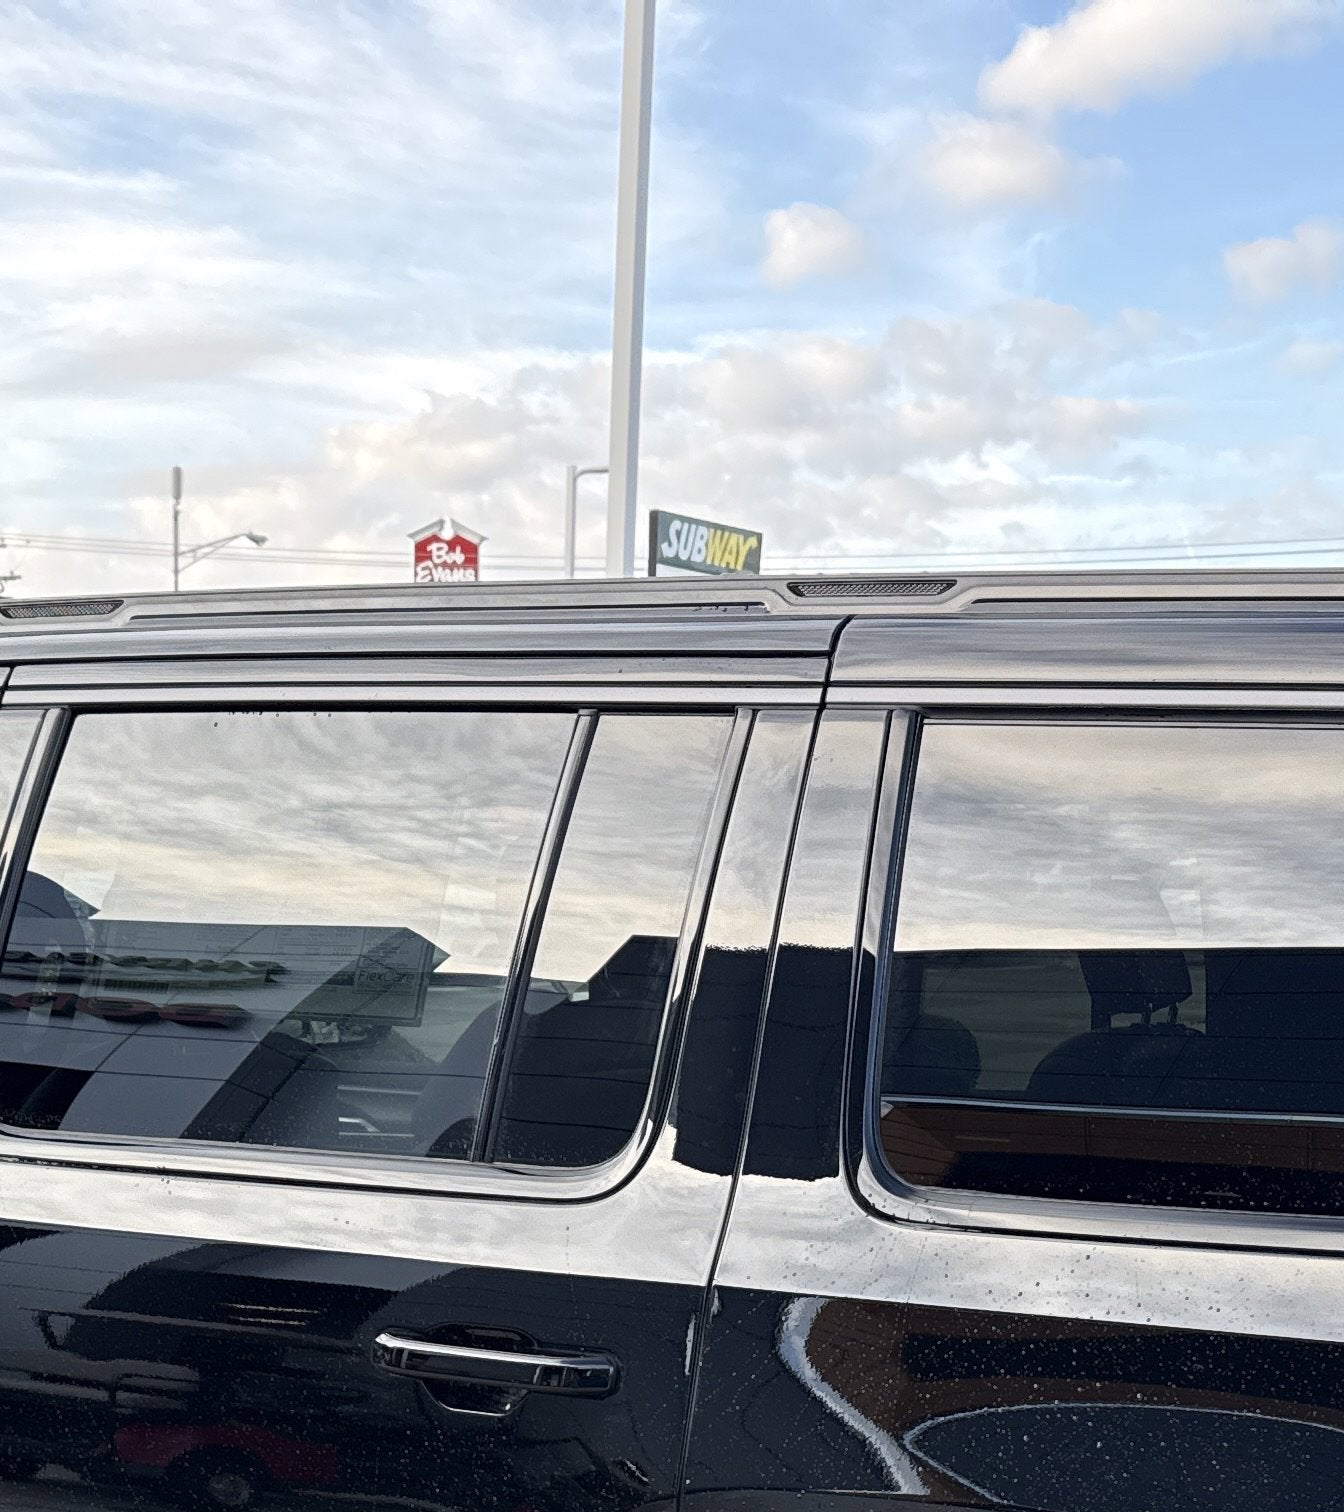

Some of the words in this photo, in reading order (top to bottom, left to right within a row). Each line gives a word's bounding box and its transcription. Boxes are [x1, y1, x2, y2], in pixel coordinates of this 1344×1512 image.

[427, 542, 465, 564] Bob
[661, 519, 757, 570] SUBWAY
[357, 969, 415, 985] FlexCare
